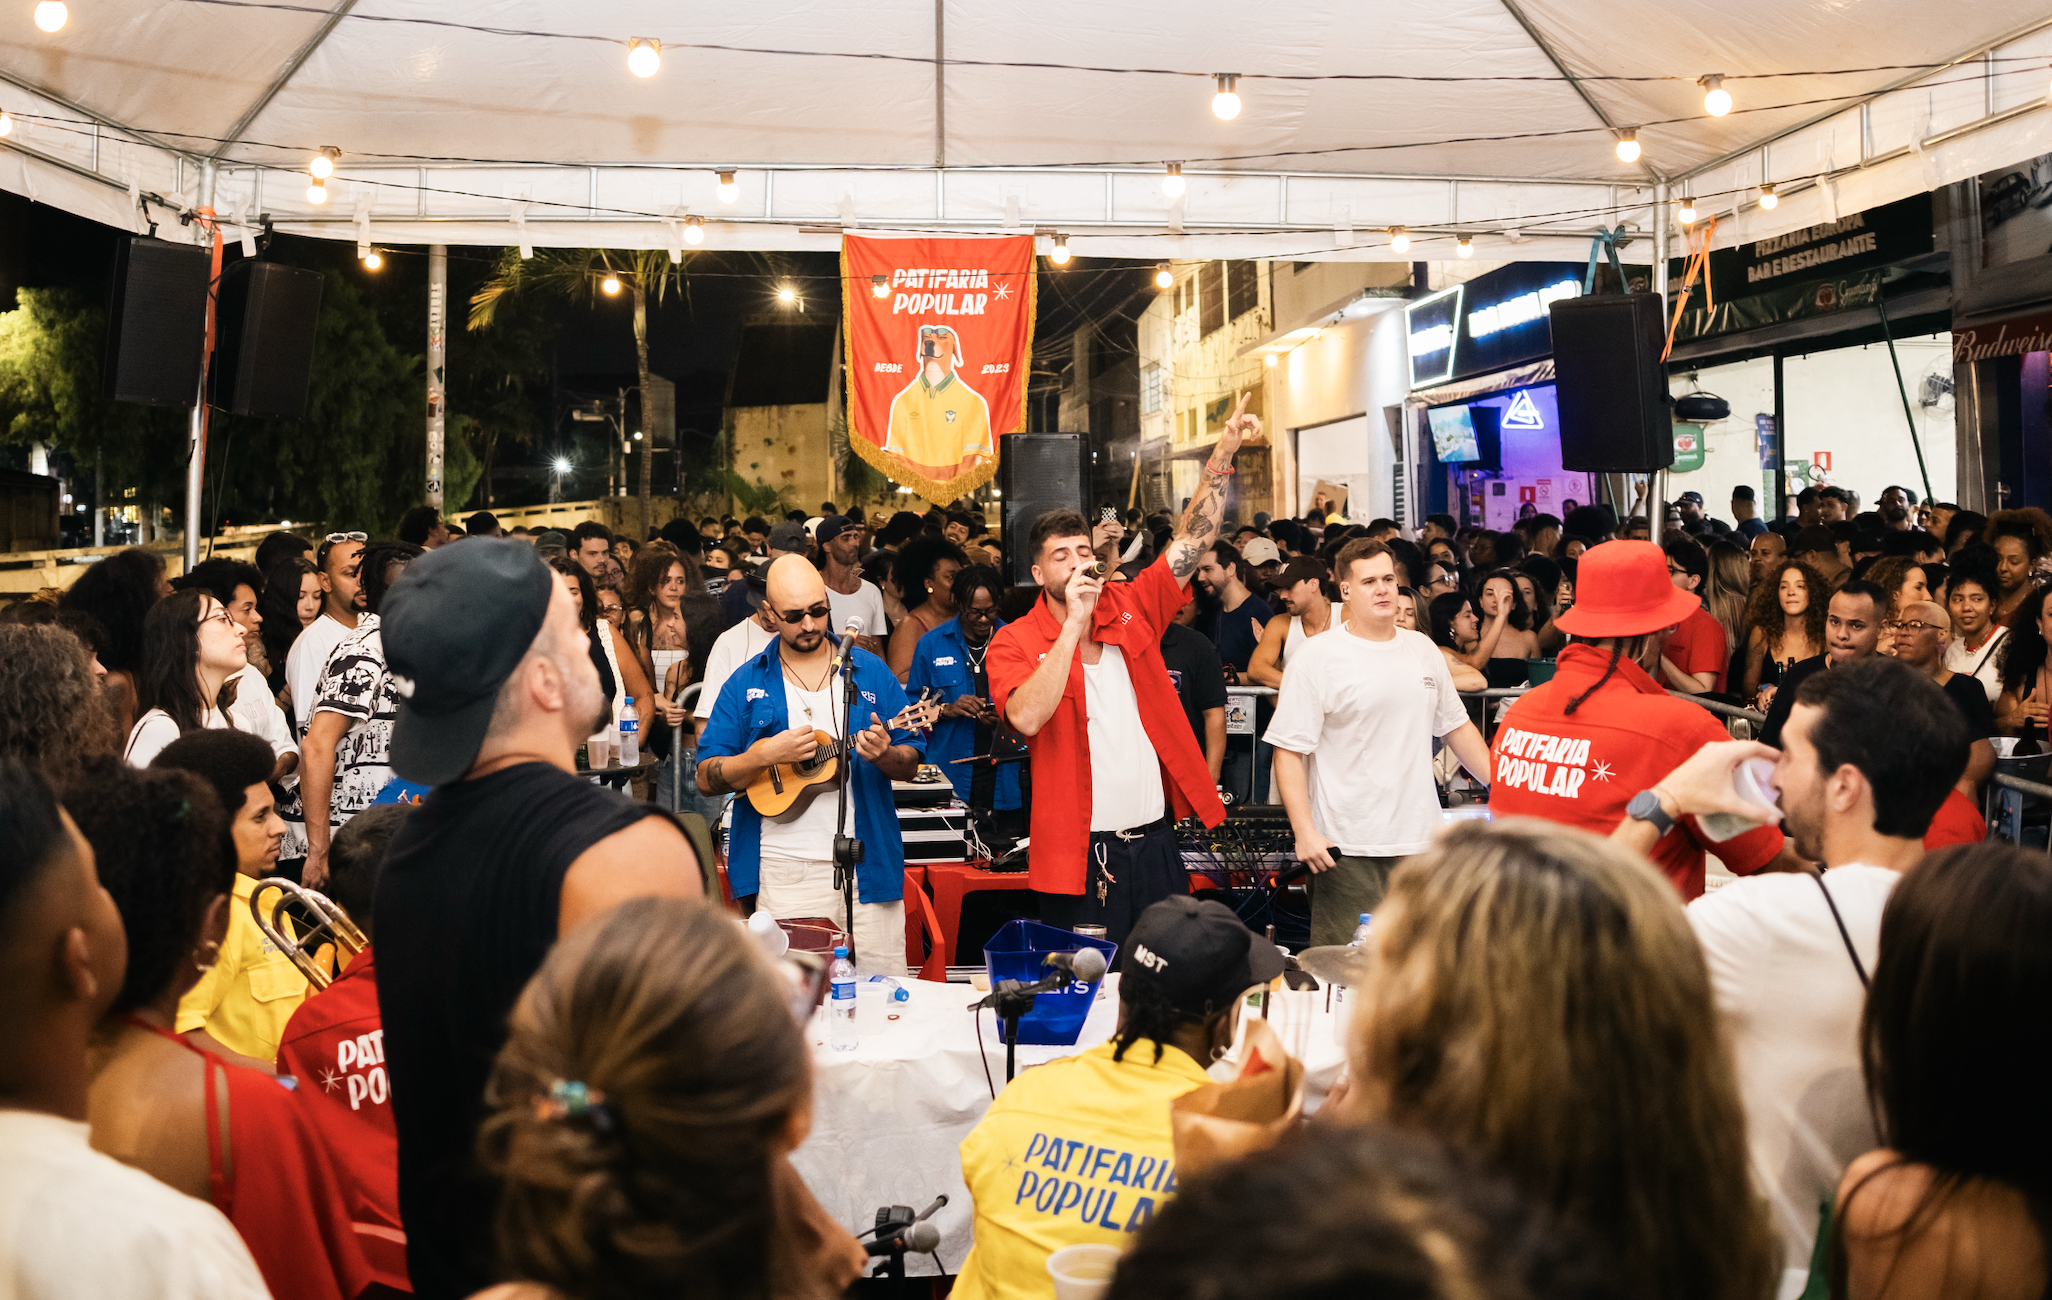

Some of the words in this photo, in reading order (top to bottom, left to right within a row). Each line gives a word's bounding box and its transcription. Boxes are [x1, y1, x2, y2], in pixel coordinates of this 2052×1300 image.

[1747, 262, 1773, 283] BAR
[1772, 258, 1782, 276] E
[1781, 232, 1877, 274] RESTAURANTE
[1755, 228, 1810, 258] PIZZARIA
[892, 268, 989, 289] PATIFARIA
[892, 293, 988, 315] POPULAR
[874, 362, 903, 374] DESDE
[981, 363, 1010, 375] 2023
[1500, 727, 1591, 767] PATIFARIA
[1497, 755, 1586, 798] POPULAR
[1134, 943, 1169, 973] MST
[347, 1067, 391, 1110] PO
